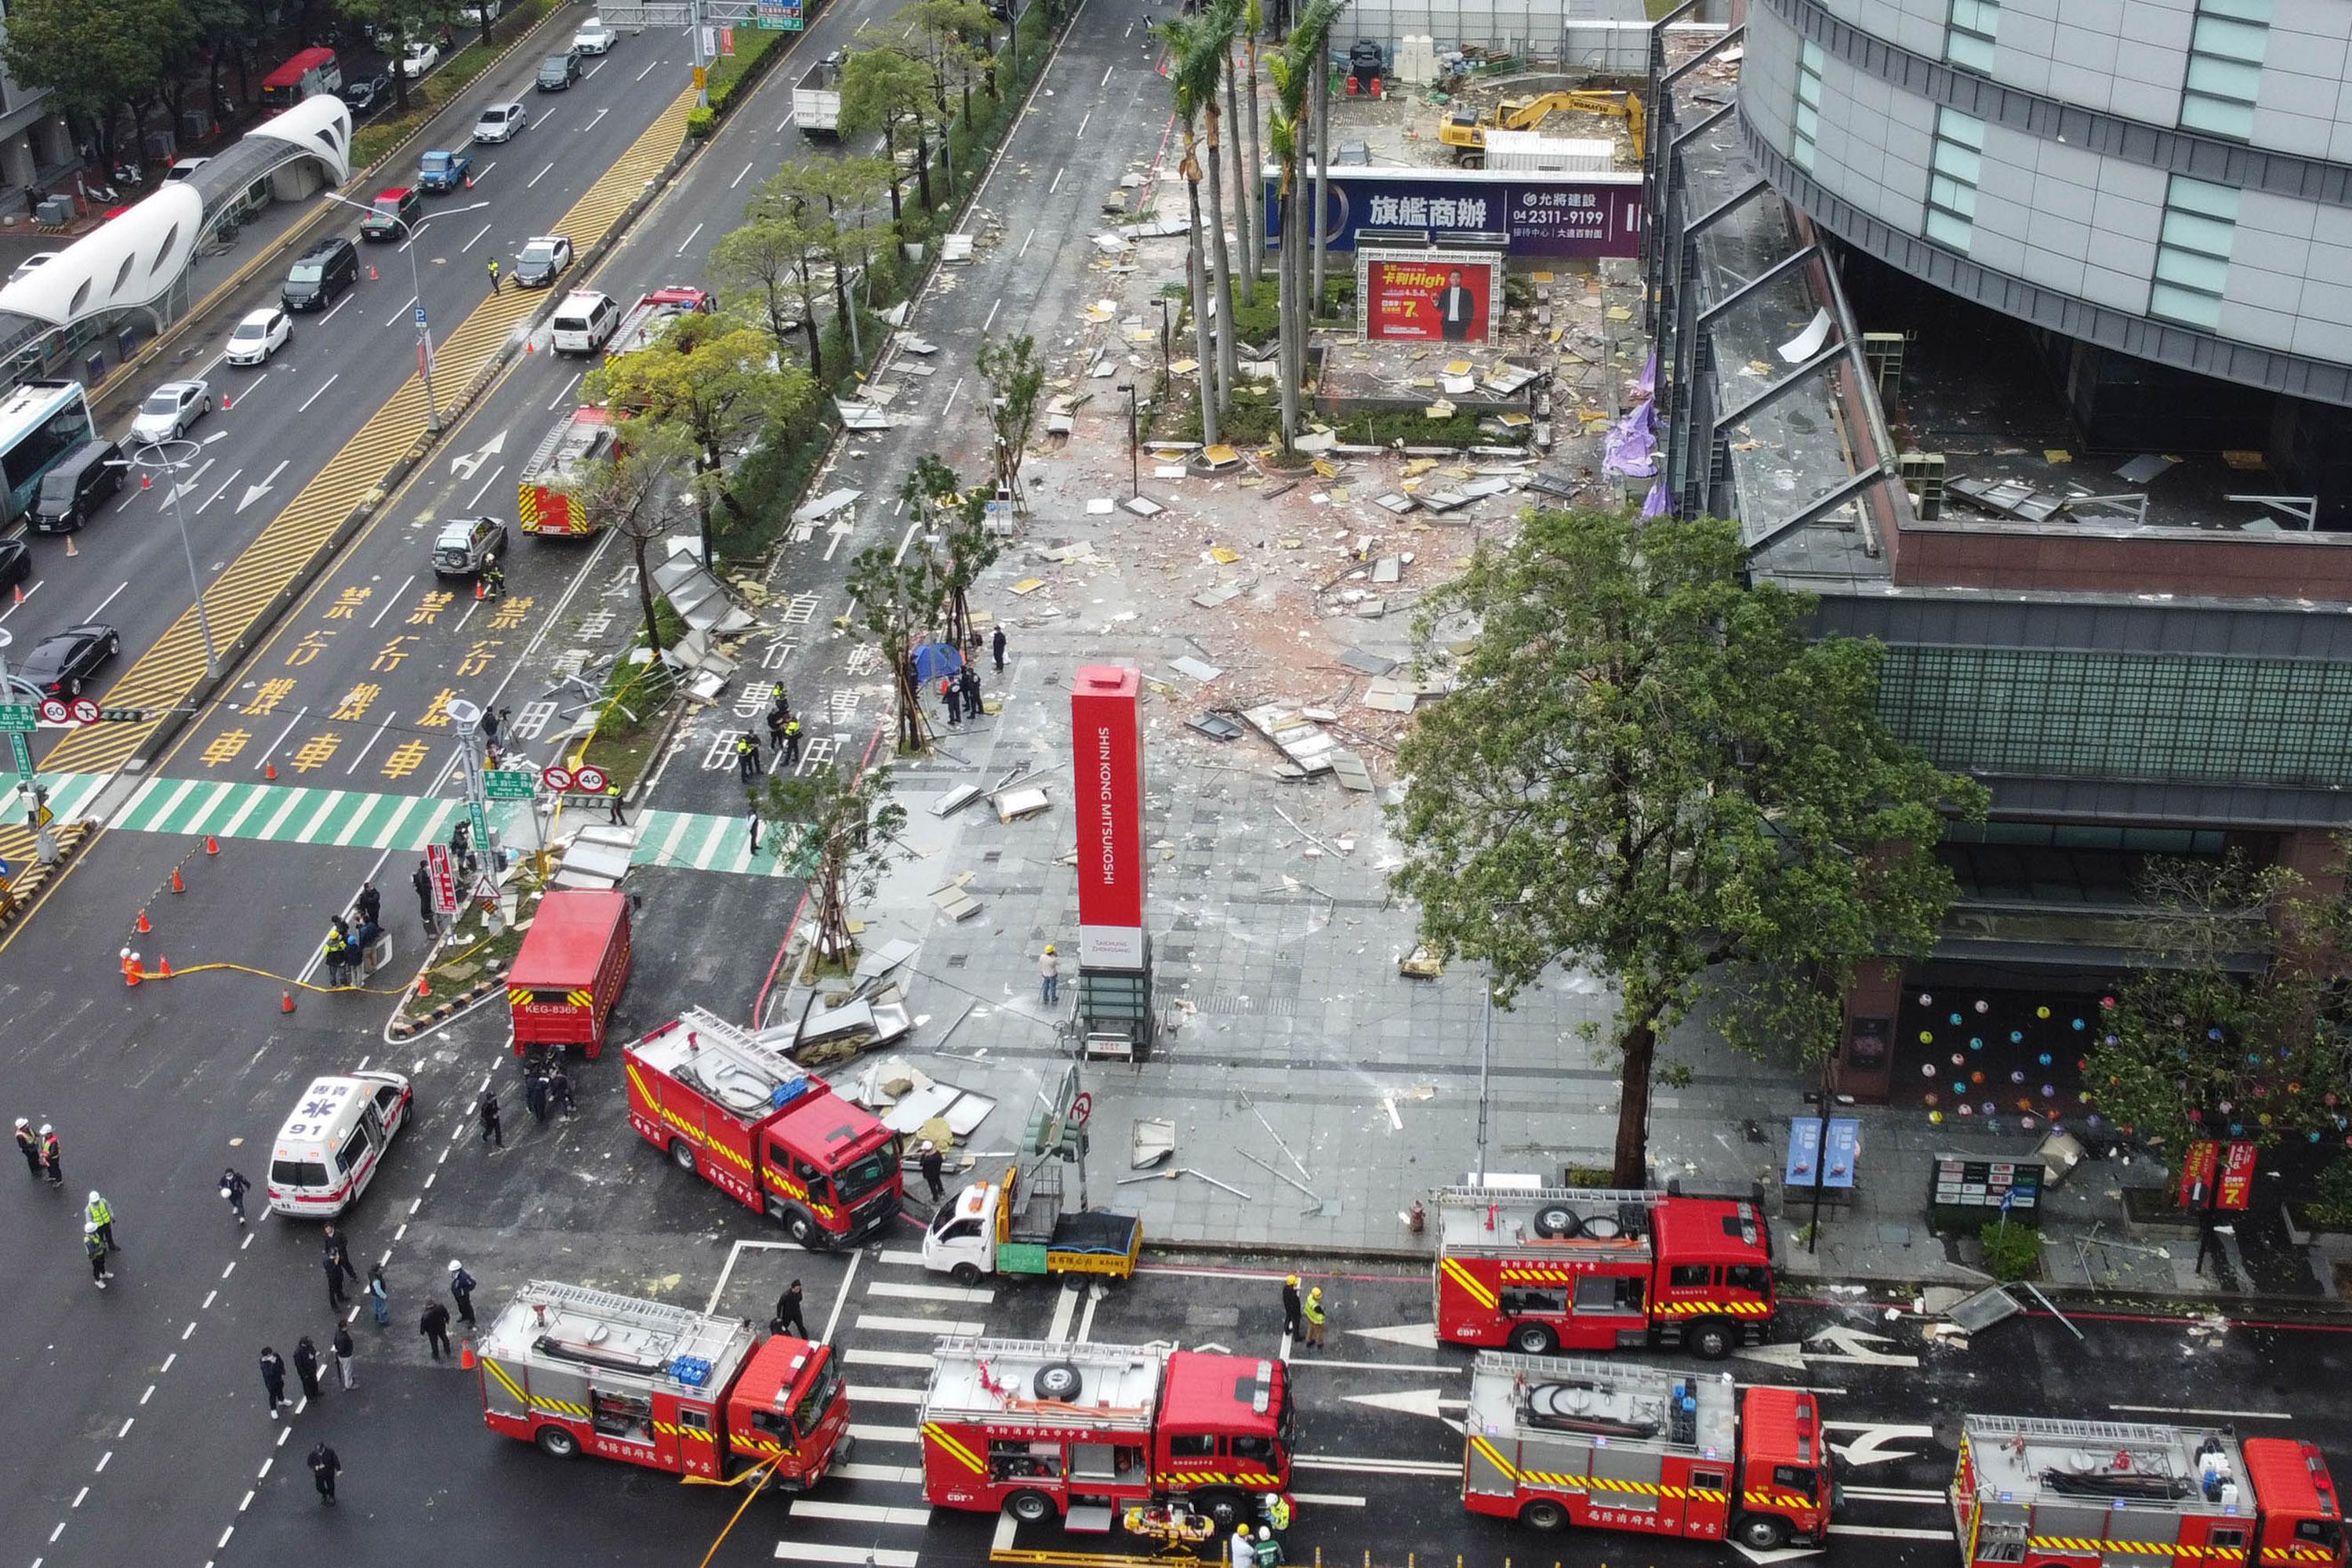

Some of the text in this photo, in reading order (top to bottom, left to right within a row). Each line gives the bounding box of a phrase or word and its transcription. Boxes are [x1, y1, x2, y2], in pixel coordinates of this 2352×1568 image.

[1573, 100, 1609, 113] KOMATSU
[1539, 193, 1597, 208] 允將建設
[1370, 195, 1487, 229] 旗艦商辦
[1513, 210, 1604, 225] 04 2311-9199
[415, 309, 426, 321] P
[47, 707, 64, 717] 60
[581, 775, 601, 785] 40
[1098, 727, 1114, 884] SHIN KONG MITSUKOSHI
[289, 1123, 322, 1135] 91
